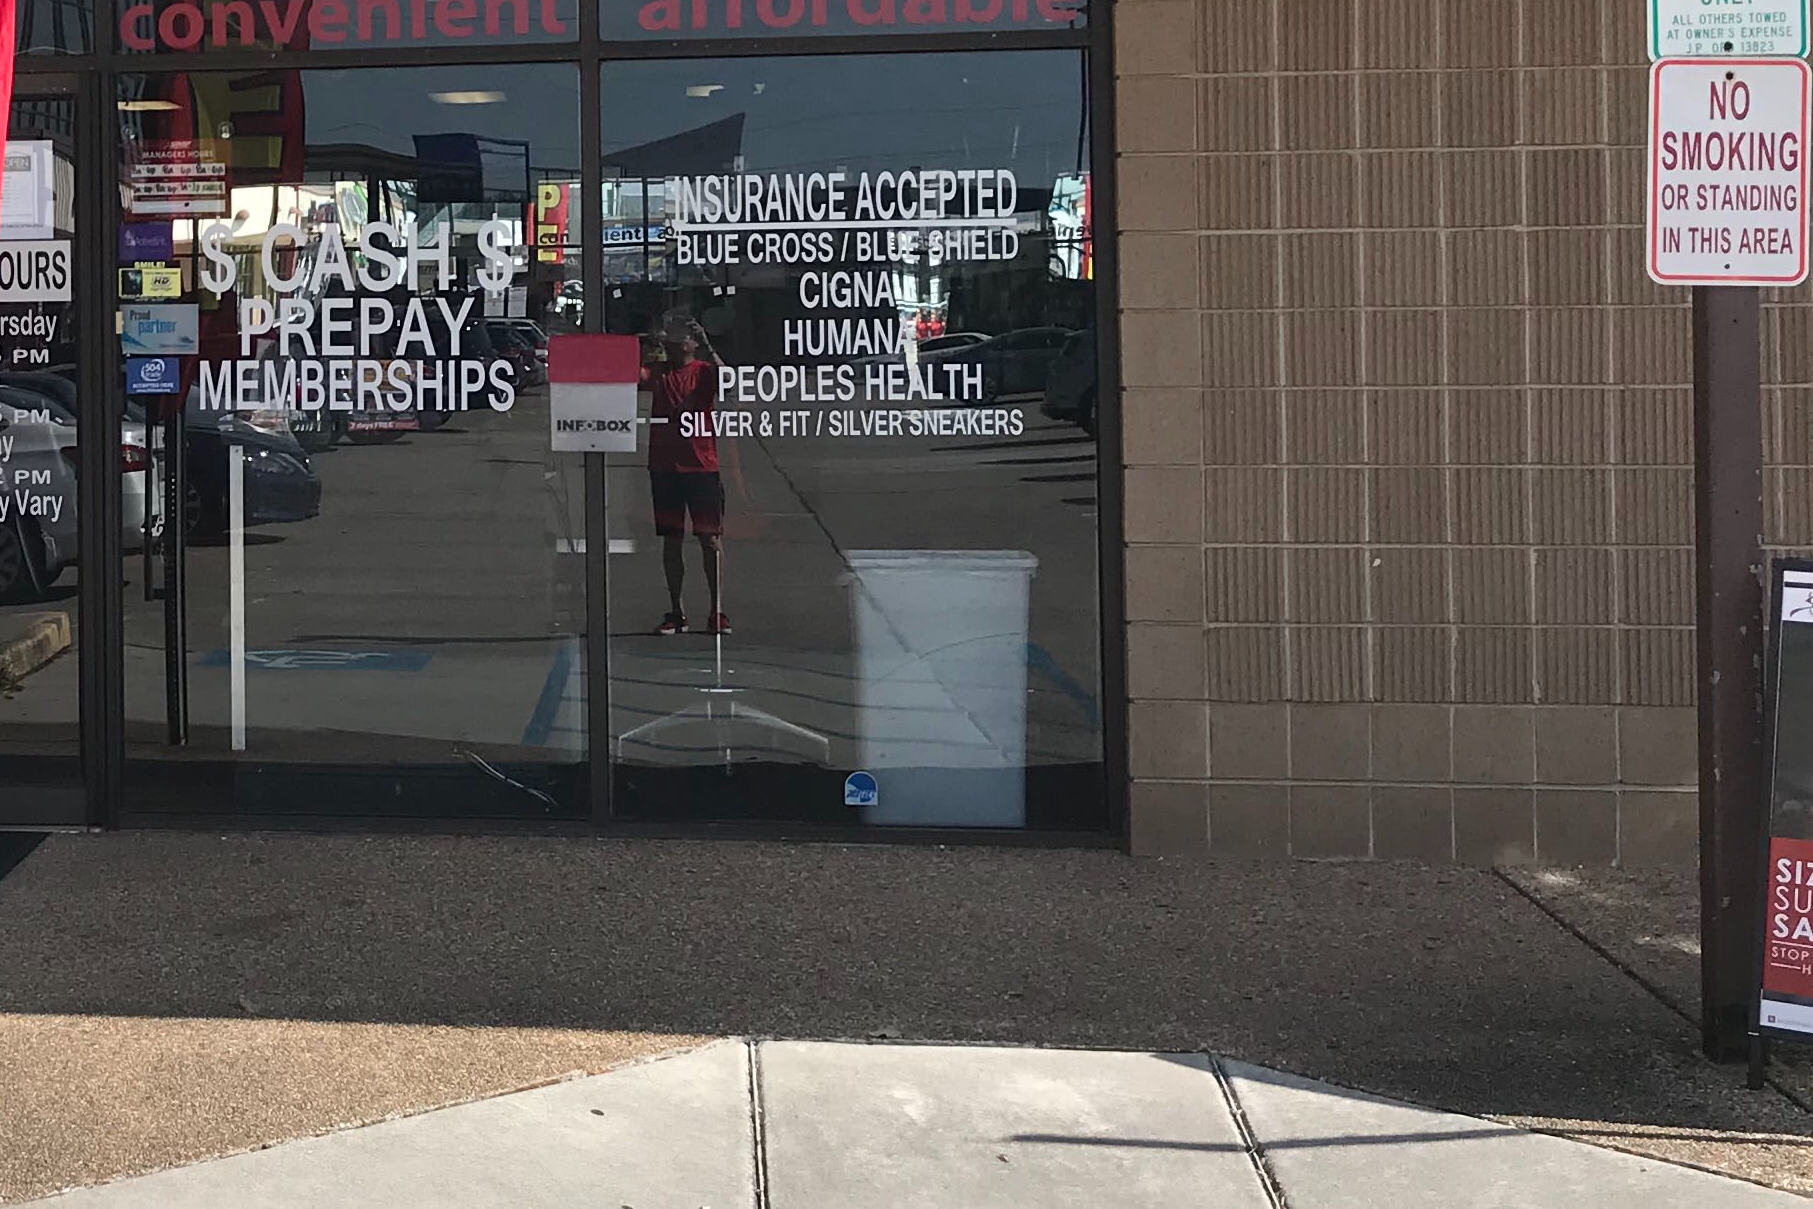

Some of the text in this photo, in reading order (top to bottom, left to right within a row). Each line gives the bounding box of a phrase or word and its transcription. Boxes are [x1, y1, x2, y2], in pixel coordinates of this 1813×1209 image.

[1667, 30, 1679, 39] AT
[1741, 26, 1793, 38] EXPENSE
[1672, 12, 1786, 25] ALL OTHERS TOWED
[1709, 81, 1750, 120] NO
[1662, 131, 1798, 171] SMOKING
[674, 169, 1017, 223] INSURANCE ACCEPTED
[1662, 184, 1797, 211] OR STANDING
[201, 217, 237, 299] $
[262, 222, 449, 293] CASH
[476, 213, 514, 298] $
[678, 233, 740, 265] BLUE
[747, 231, 834, 263] CROSS
[857, 230, 922, 263] BLUE
[929, 229, 1019, 261] SHIELD
[1663, 227, 1793, 254] IN THIS AREA
[799, 271, 895, 309] CIGNA
[138, 320, 176, 335] partner
[241, 297, 474, 357] PREPAY
[784, 318, 915, 356] HUMANA
[13, 348, 49, 364] PM
[199, 359, 515, 412] MEMBERSHIPS
[718, 363, 982, 402] PEOPLES HEALTH
[14, 409, 50, 423] PM
[680, 408, 1024, 437] SILVER & FIT SILVER SNEAKERS
[15, 469, 51, 484] PM
[15, 489, 63, 522] Vary
[1771, 946, 1810, 961] STOP
